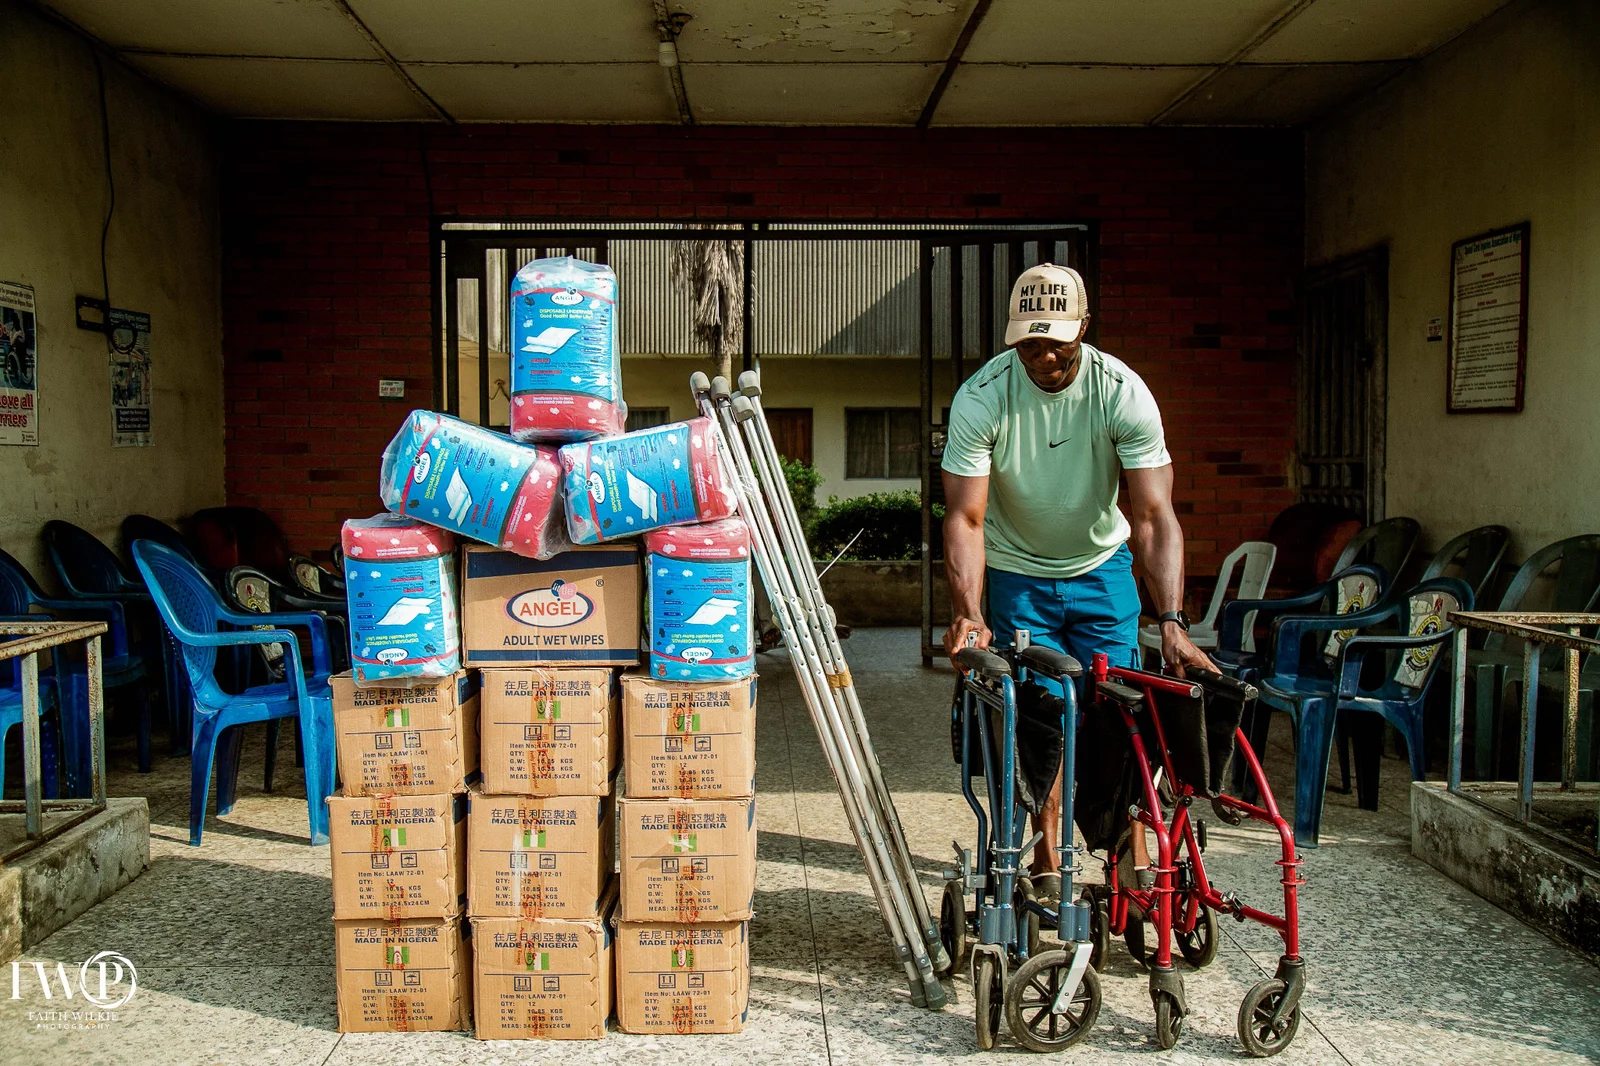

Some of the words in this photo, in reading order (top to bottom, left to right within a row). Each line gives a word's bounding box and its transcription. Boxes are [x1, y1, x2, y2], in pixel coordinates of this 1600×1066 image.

[1020, 285, 1036, 297] MY
[1040, 284, 1068, 295] LIFE
[1019, 297, 1045, 313] ALL
[1050, 297, 1067, 312] IN
[0, 394, 19, 408] ove
[21, 394, 33, 409] all
[417, 457, 428, 481] ANGEL
[593, 477, 602, 500] ANGEL
[552, 582, 574, 595] little
[520, 602, 583, 617] ANGEL
[503, 635, 540, 645] ADULT
[543, 635, 567, 645] WET
[569, 635, 604, 645] WIPES
[381, 652, 405, 660] ANGEL
